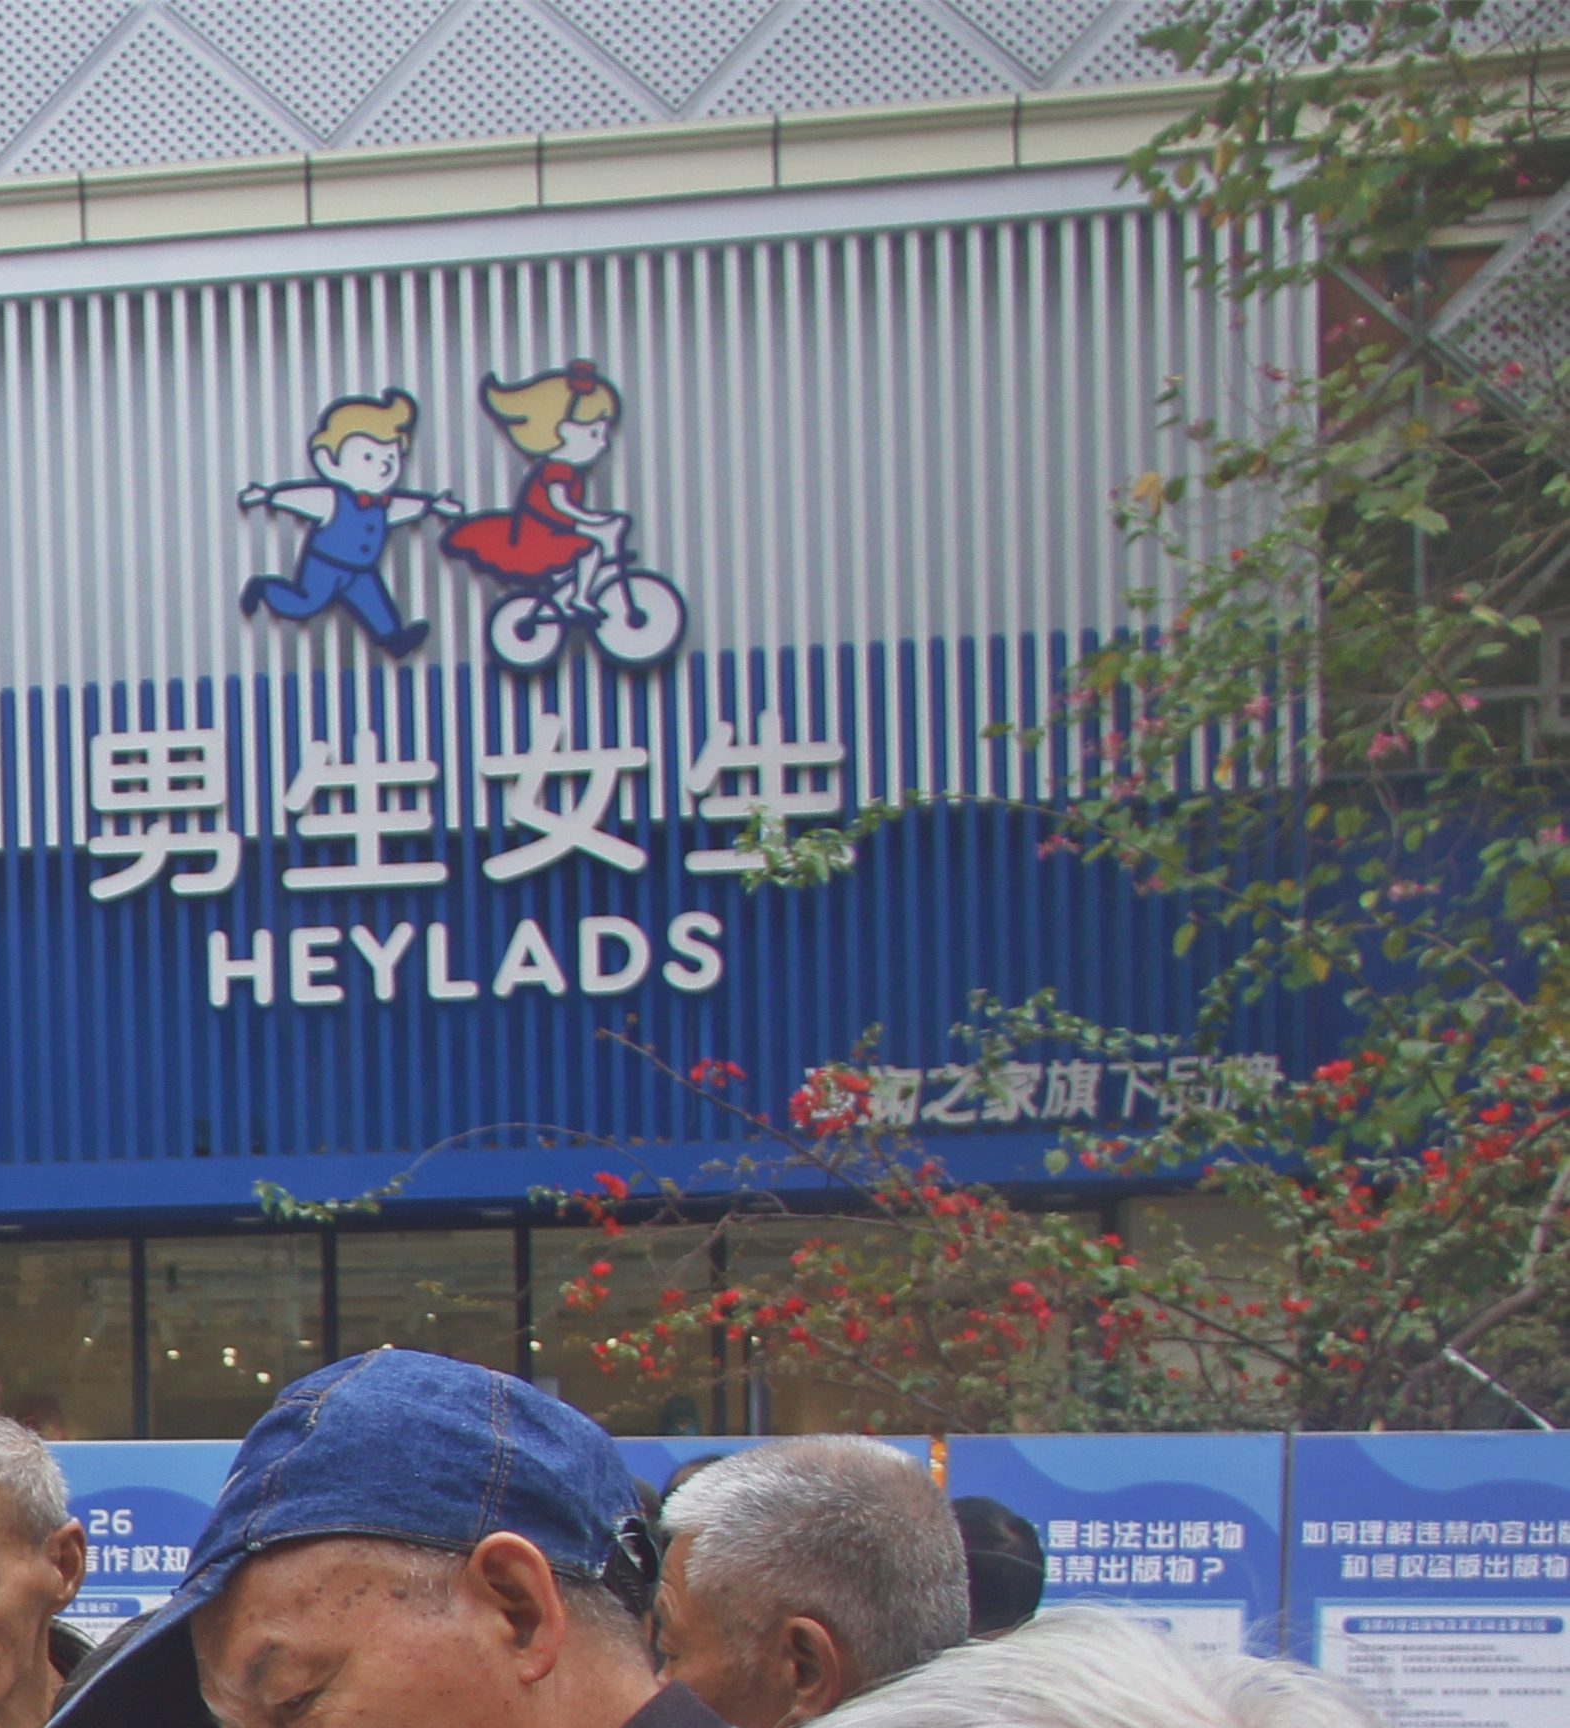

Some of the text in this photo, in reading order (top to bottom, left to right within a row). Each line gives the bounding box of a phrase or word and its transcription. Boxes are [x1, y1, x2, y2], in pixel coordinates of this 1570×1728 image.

[87, 709, 855, 902] 男生女生
[207, 911, 724, 1008] HEYLADS
[794, 1051, 1284, 1127] 澜之家旗下品牌
[88, 1508, 133, 1535] 26
[1033, 1519, 1246, 1549] 是非法出版物
